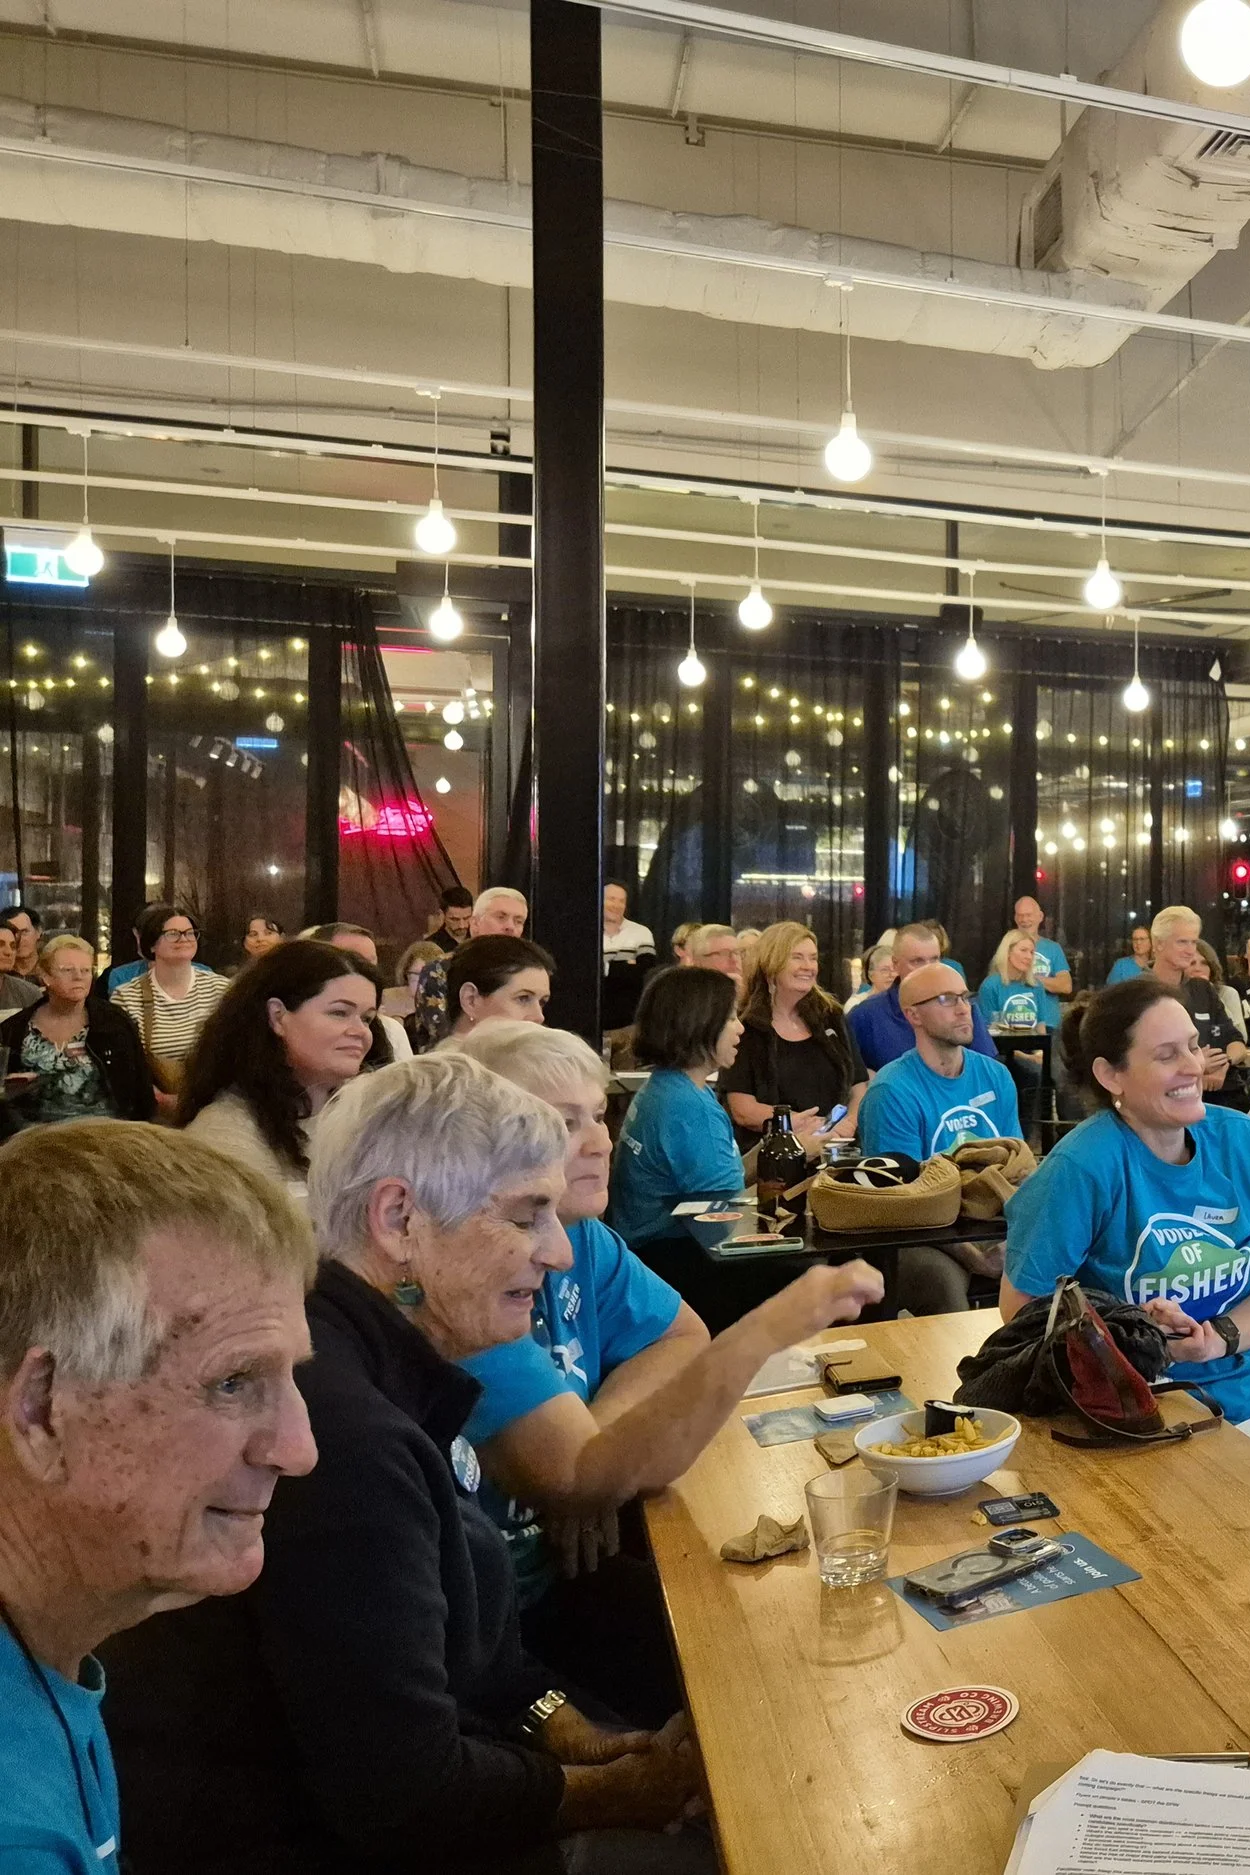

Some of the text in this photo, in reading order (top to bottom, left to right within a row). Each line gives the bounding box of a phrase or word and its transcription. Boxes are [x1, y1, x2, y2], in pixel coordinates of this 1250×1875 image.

[1151, 1228, 1212, 1246] VOICE
[1181, 1243, 1203, 1265] OF
[1138, 1257, 1247, 1304] FISHER
[563, 1283, 581, 1321] FISHER
[1083, 1565, 1108, 1580] Join
[916, 1702, 958, 1734] SLIPSTREAM
[981, 1693, 1003, 1725] BREWING
